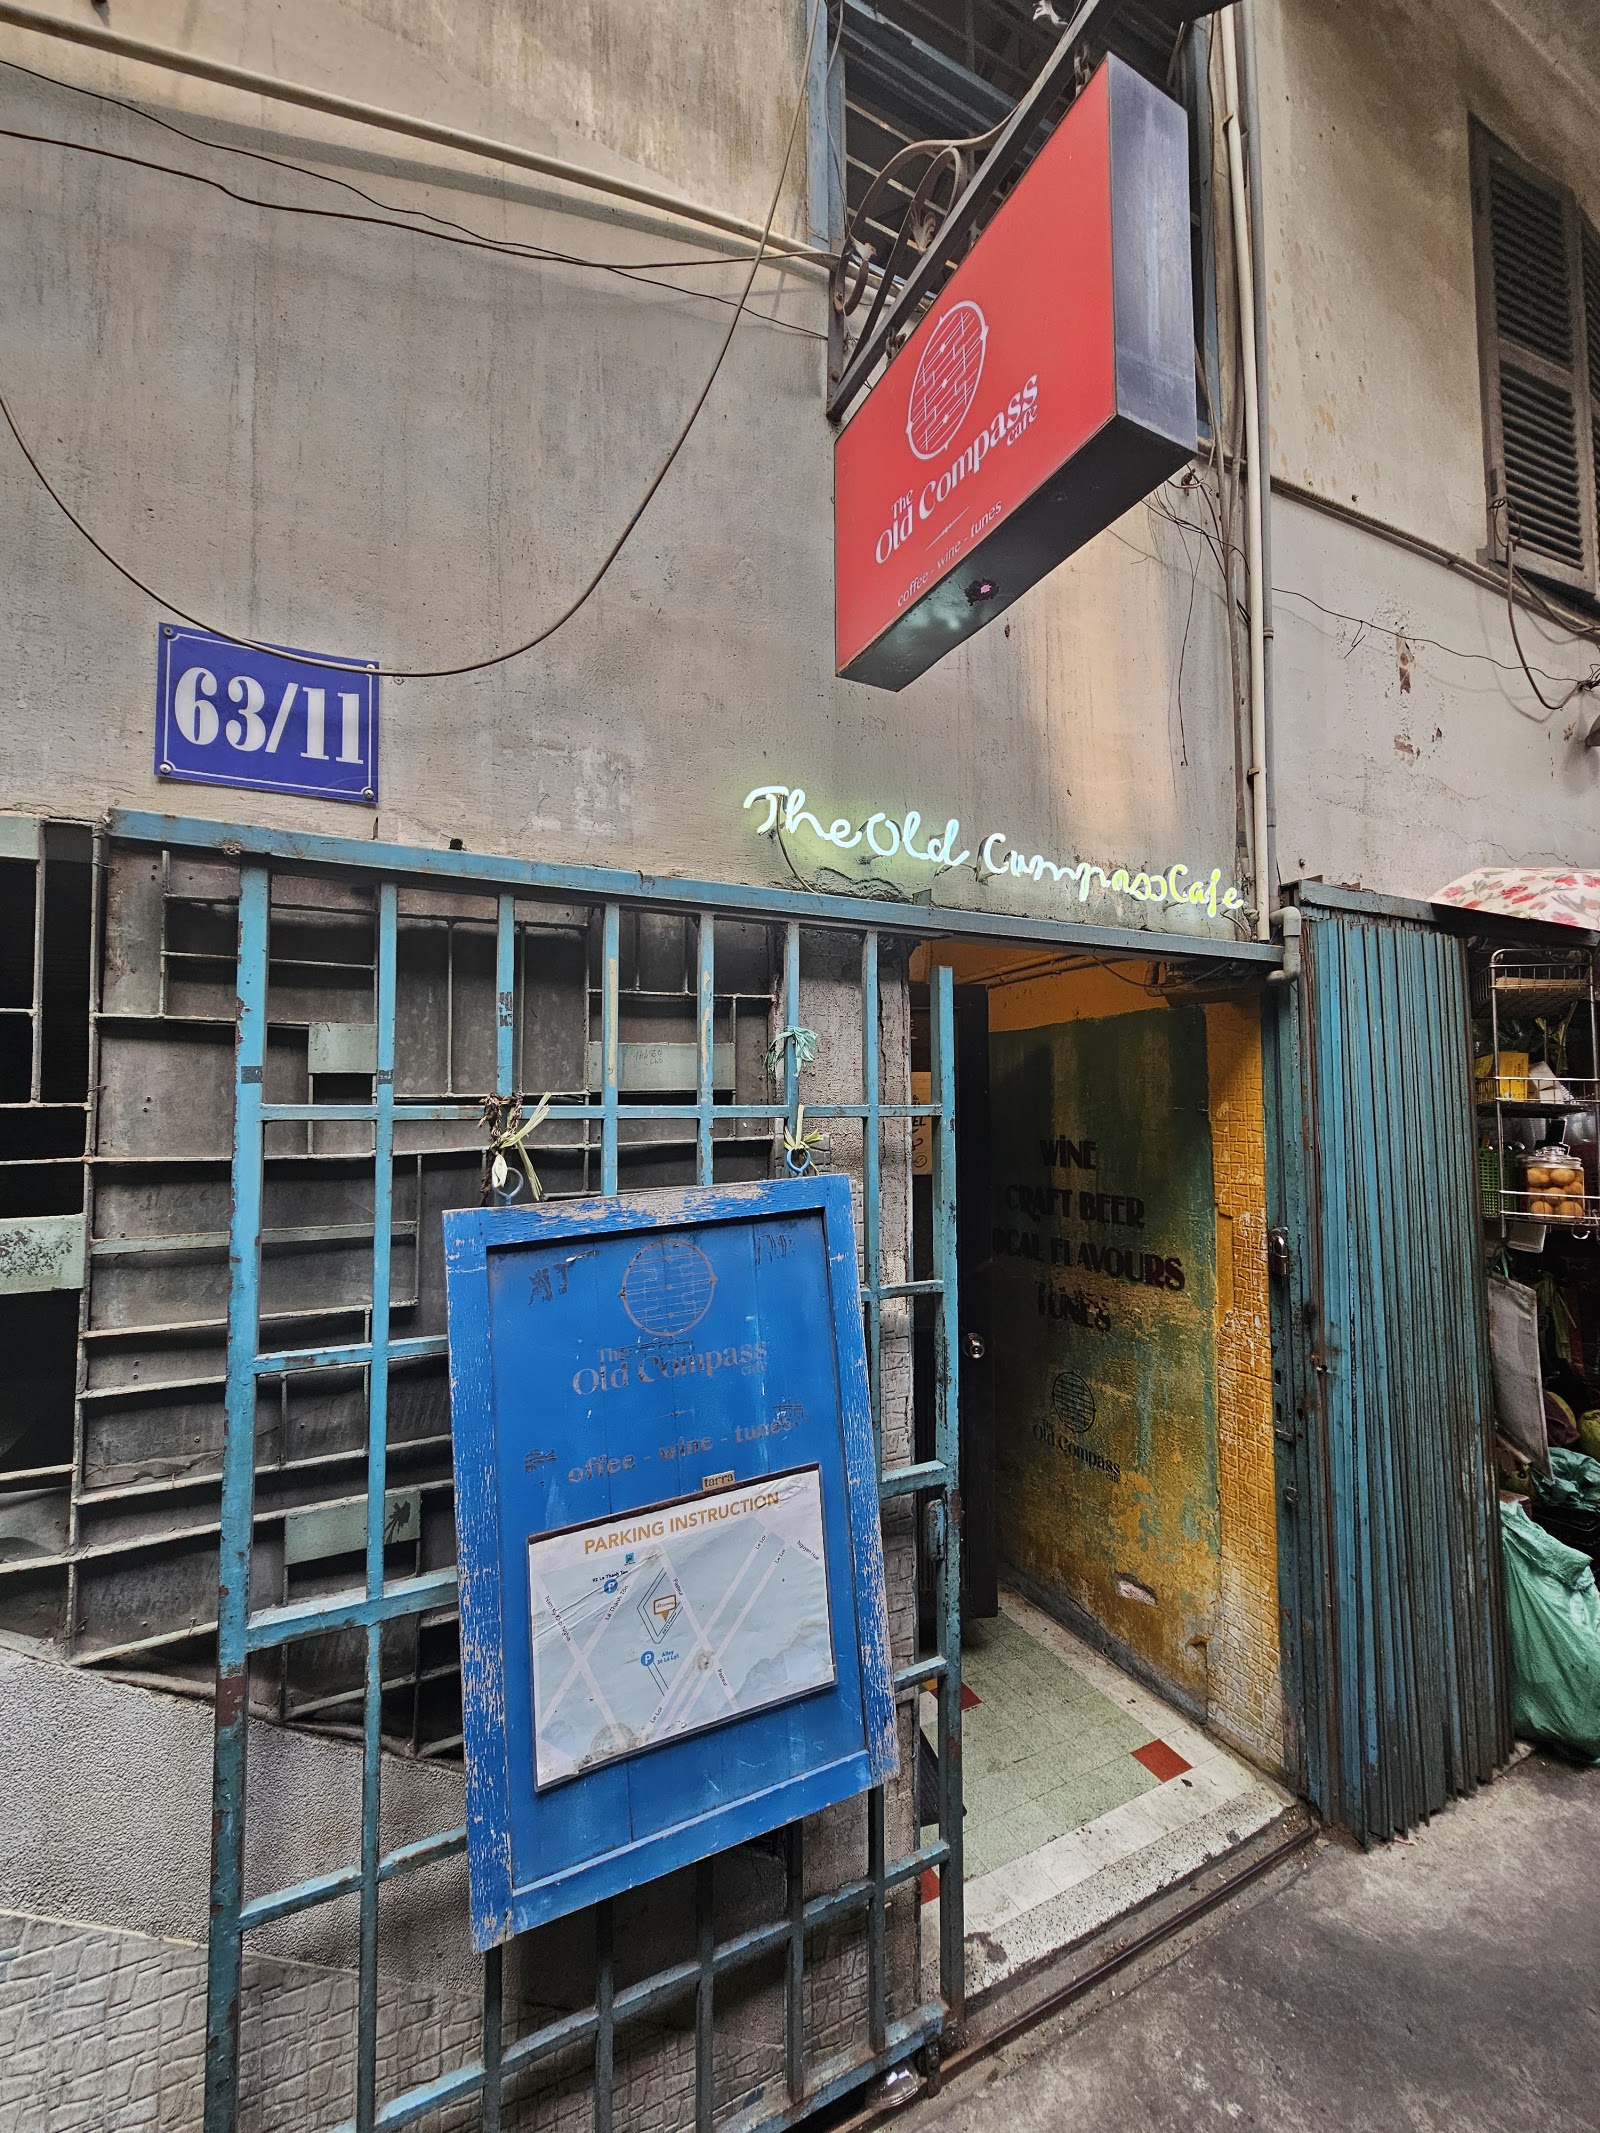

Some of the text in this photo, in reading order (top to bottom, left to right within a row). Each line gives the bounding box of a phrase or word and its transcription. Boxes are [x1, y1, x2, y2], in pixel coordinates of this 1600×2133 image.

[874, 373, 1039, 565] Old Compass
[891, 489, 914, 520] The
[897, 500, 1002, 607] coffee wine tunes
[174, 666, 364, 765] 63/11
[742, 784, 863, 849] The
[866, 810, 970, 867] Old
[1168, 863, 1244, 918] Cafe
[1079, 1190, 1146, 1230] BEER
[1049, 1236, 1186, 1291] FLAVOURS
[572, 1341, 768, 1396] Old Compass
[659, 1435, 713, 1462] wine
[734, 1415, 794, 1444] tunes
[704, 1472, 735, 1489] tarra
[584, 1491, 780, 1555] PARKING INSTRUCTION
